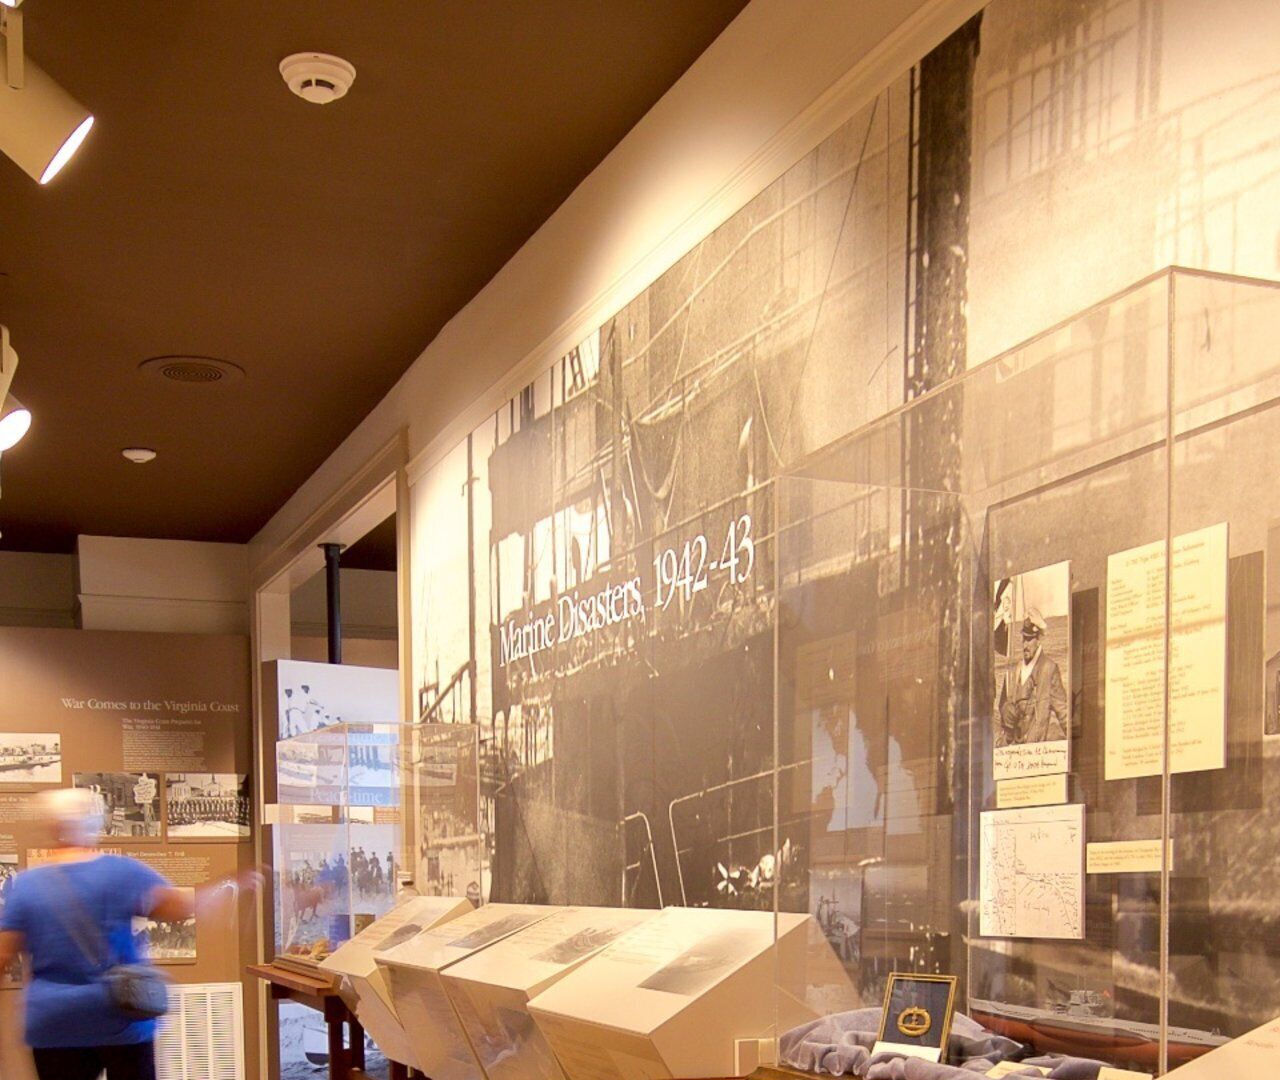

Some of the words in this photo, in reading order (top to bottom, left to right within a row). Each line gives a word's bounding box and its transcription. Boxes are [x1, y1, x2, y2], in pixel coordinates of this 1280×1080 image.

[499, 611, 555, 667] Marine
[557, 577, 646, 645] Disasters,
[653, 514, 755, 612] 1942-43
[61, 698, 85, 710] War
[87, 698, 128, 711] Comes
[129, 700, 141, 711] to
[143, 699, 162, 712] the
[163, 700, 208, 713] Virginia
[209, 701, 240, 713] Coast
